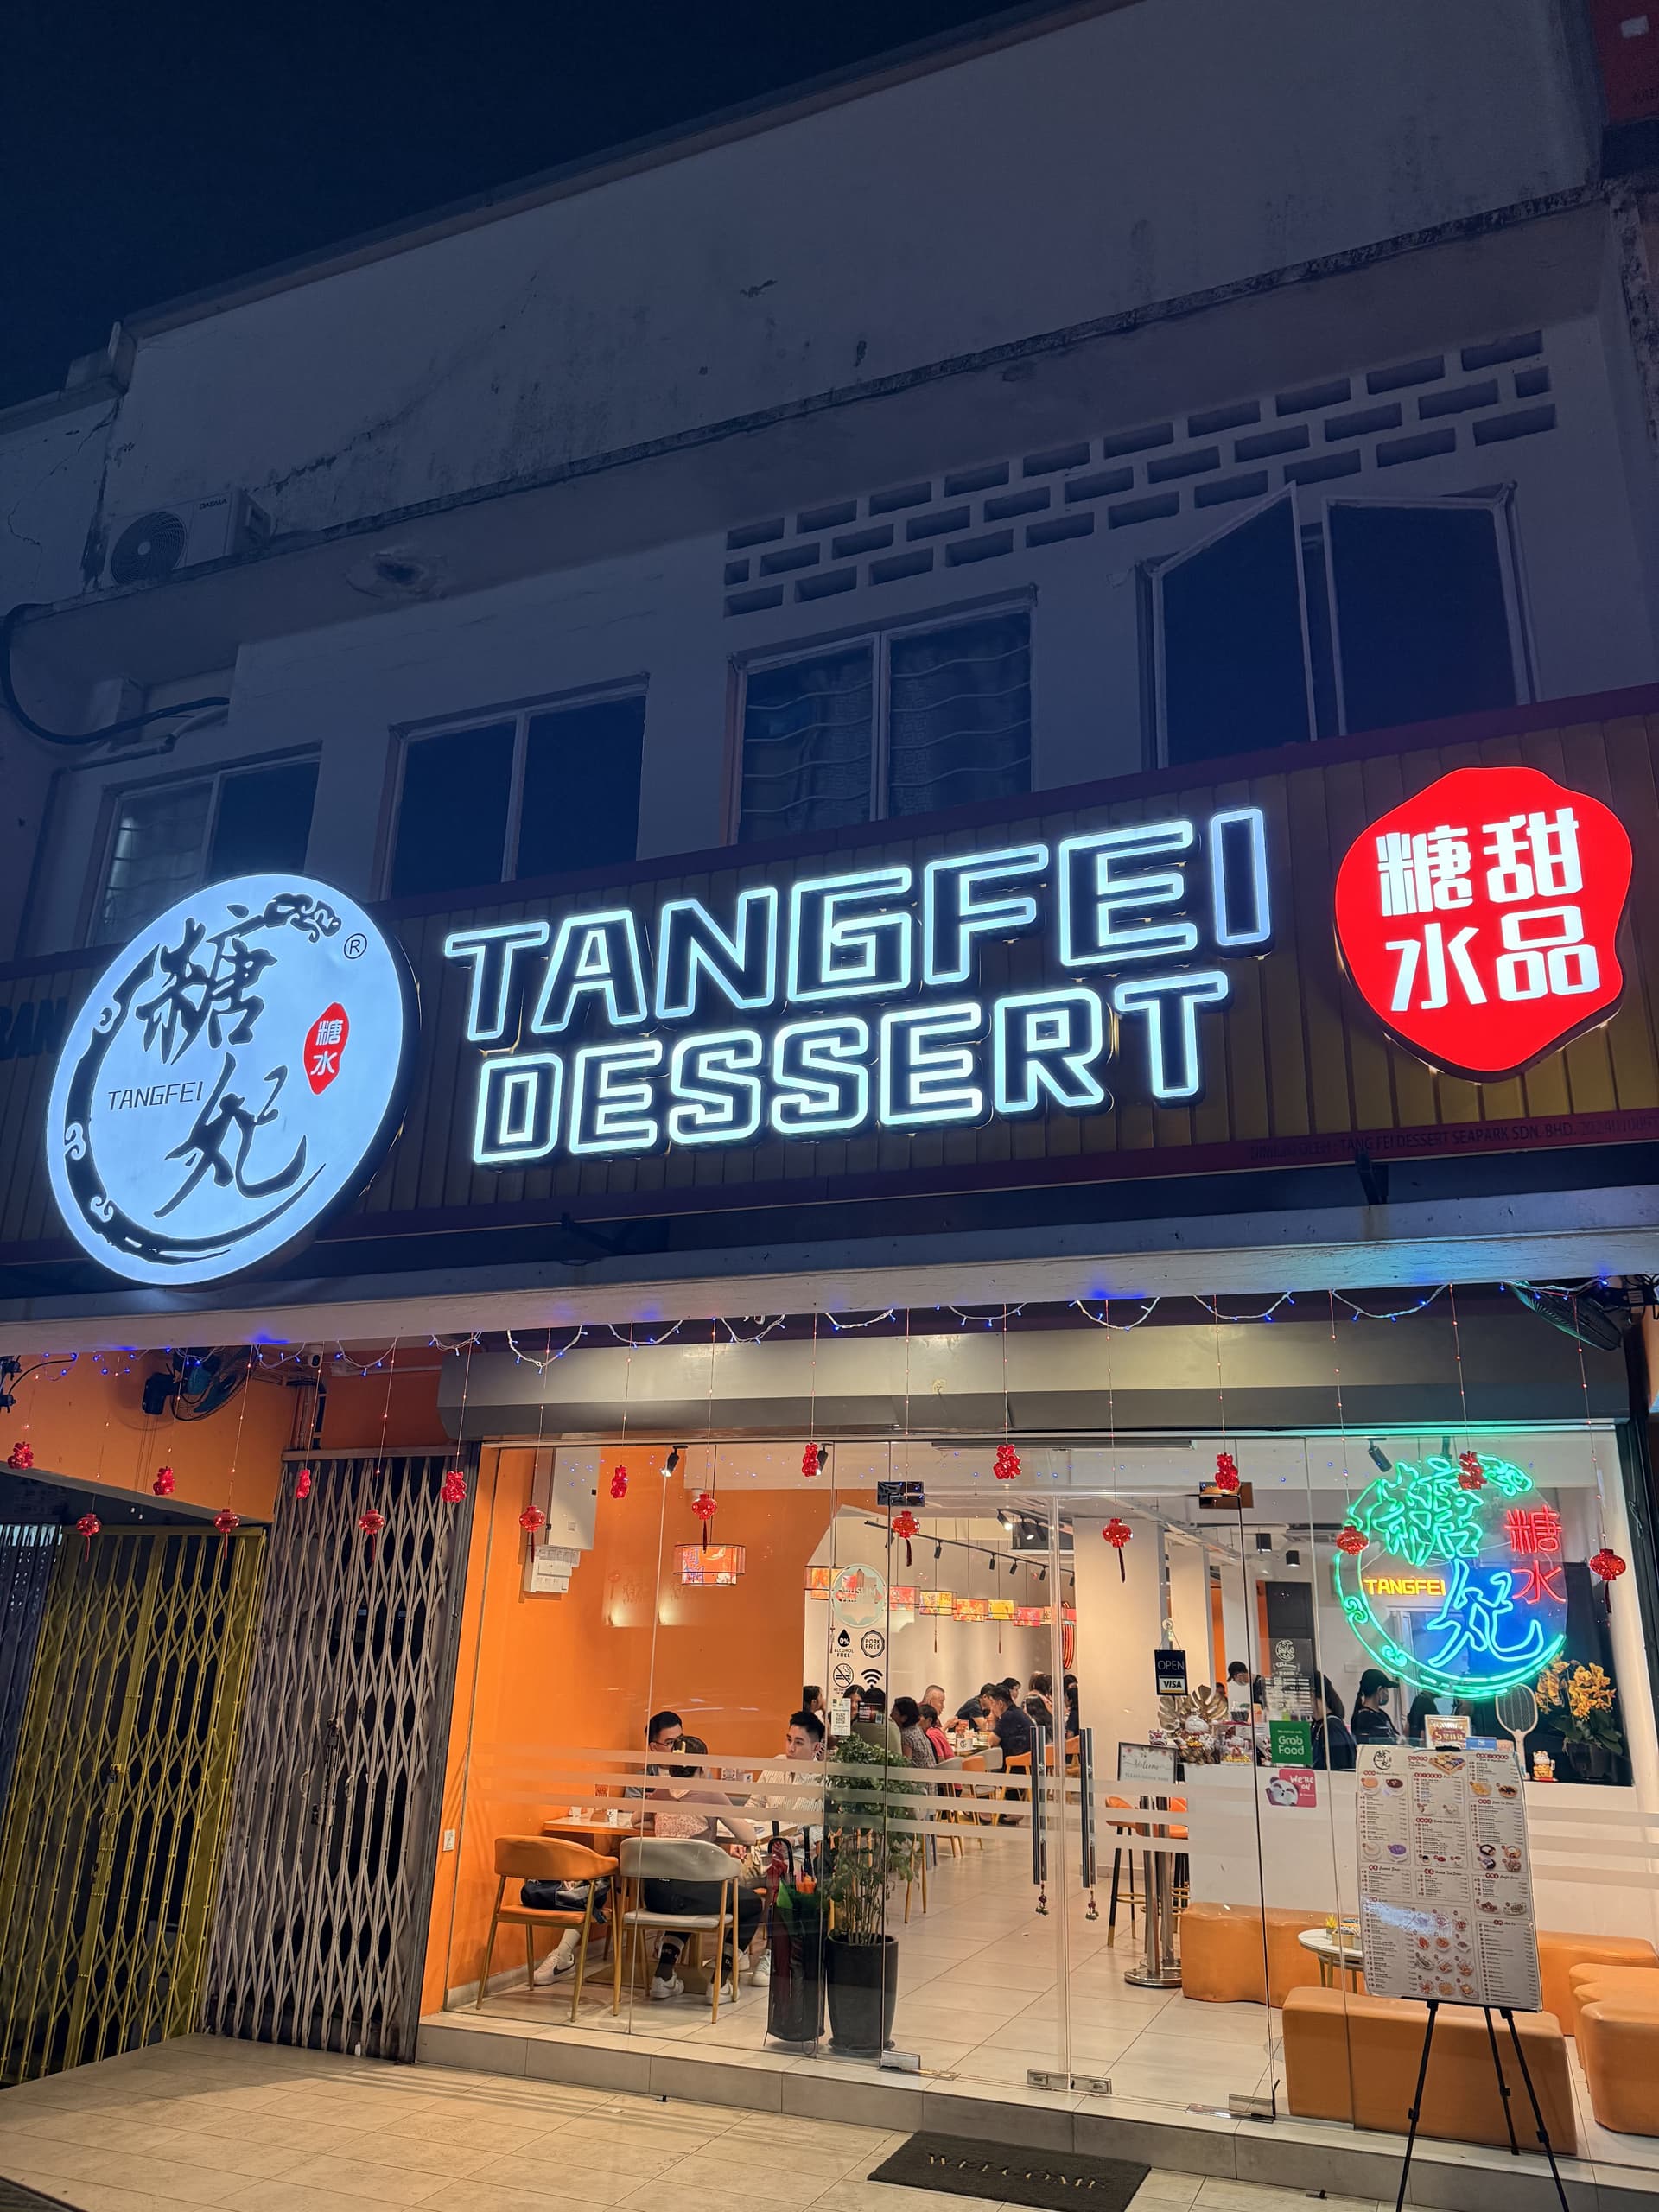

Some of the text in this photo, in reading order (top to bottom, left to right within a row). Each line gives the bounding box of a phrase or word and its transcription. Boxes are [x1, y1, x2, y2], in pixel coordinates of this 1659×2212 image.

[444, 807, 1272, 1042] TANGFEI
[472, 969, 1230, 1166] DESSERT
[107, 1080, 204, 1112] TANGFEI
[1452, 1126, 1509, 1145] SEAPARK
[1545, 1121, 1577, 1138] BHD.
[1363, 1577, 1446, 1597] TANGFEI
[1157, 1659, 1185, 1671] OPEN
[1163, 1680, 1182, 1689] VISA
[1278, 1735, 1303, 1746] Grab
[1278, 1745, 1305, 1757] Food
